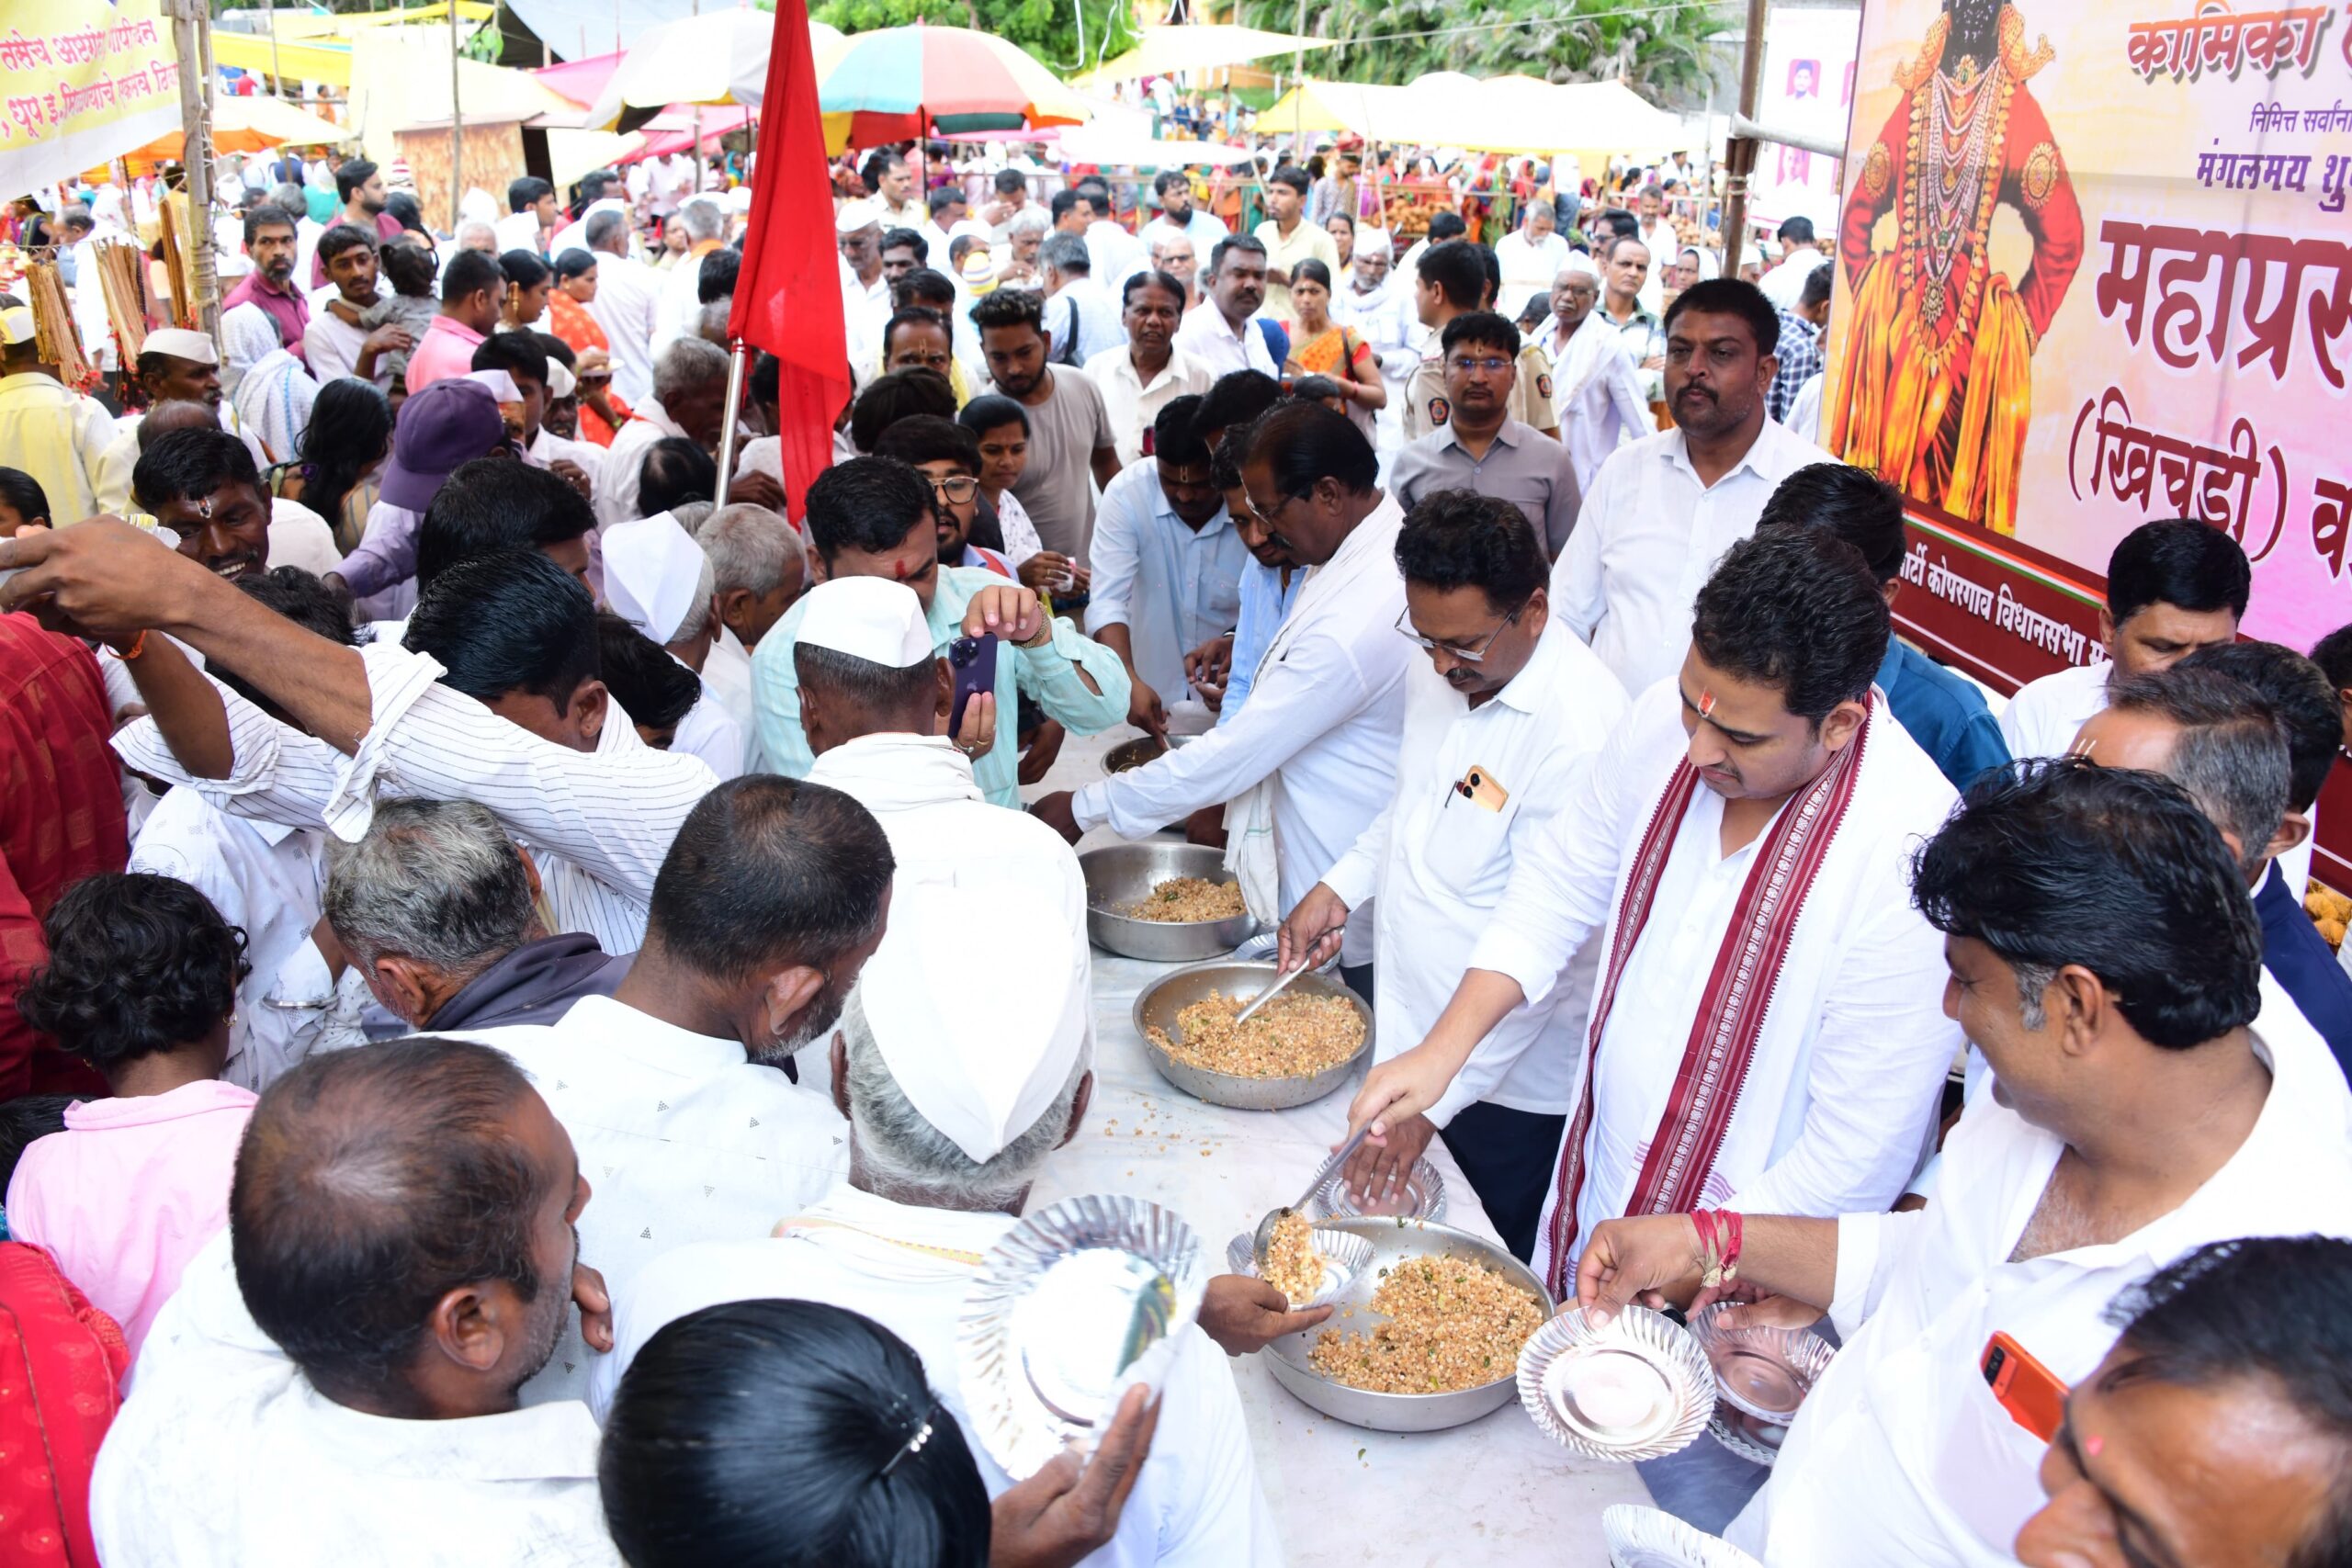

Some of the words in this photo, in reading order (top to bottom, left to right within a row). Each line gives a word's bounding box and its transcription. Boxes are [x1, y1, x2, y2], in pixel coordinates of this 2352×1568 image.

[2127, 0, 2329, 77] कामिका
[2249, 101, 2300, 133] निमित्त
[2197, 137, 2312, 192] मंगलमय
[2318, 154, 2352, 213] शु
[1928, 555, 1995, 622] कोपरगाव
[1996, 582, 2086, 666] विधानसभा
